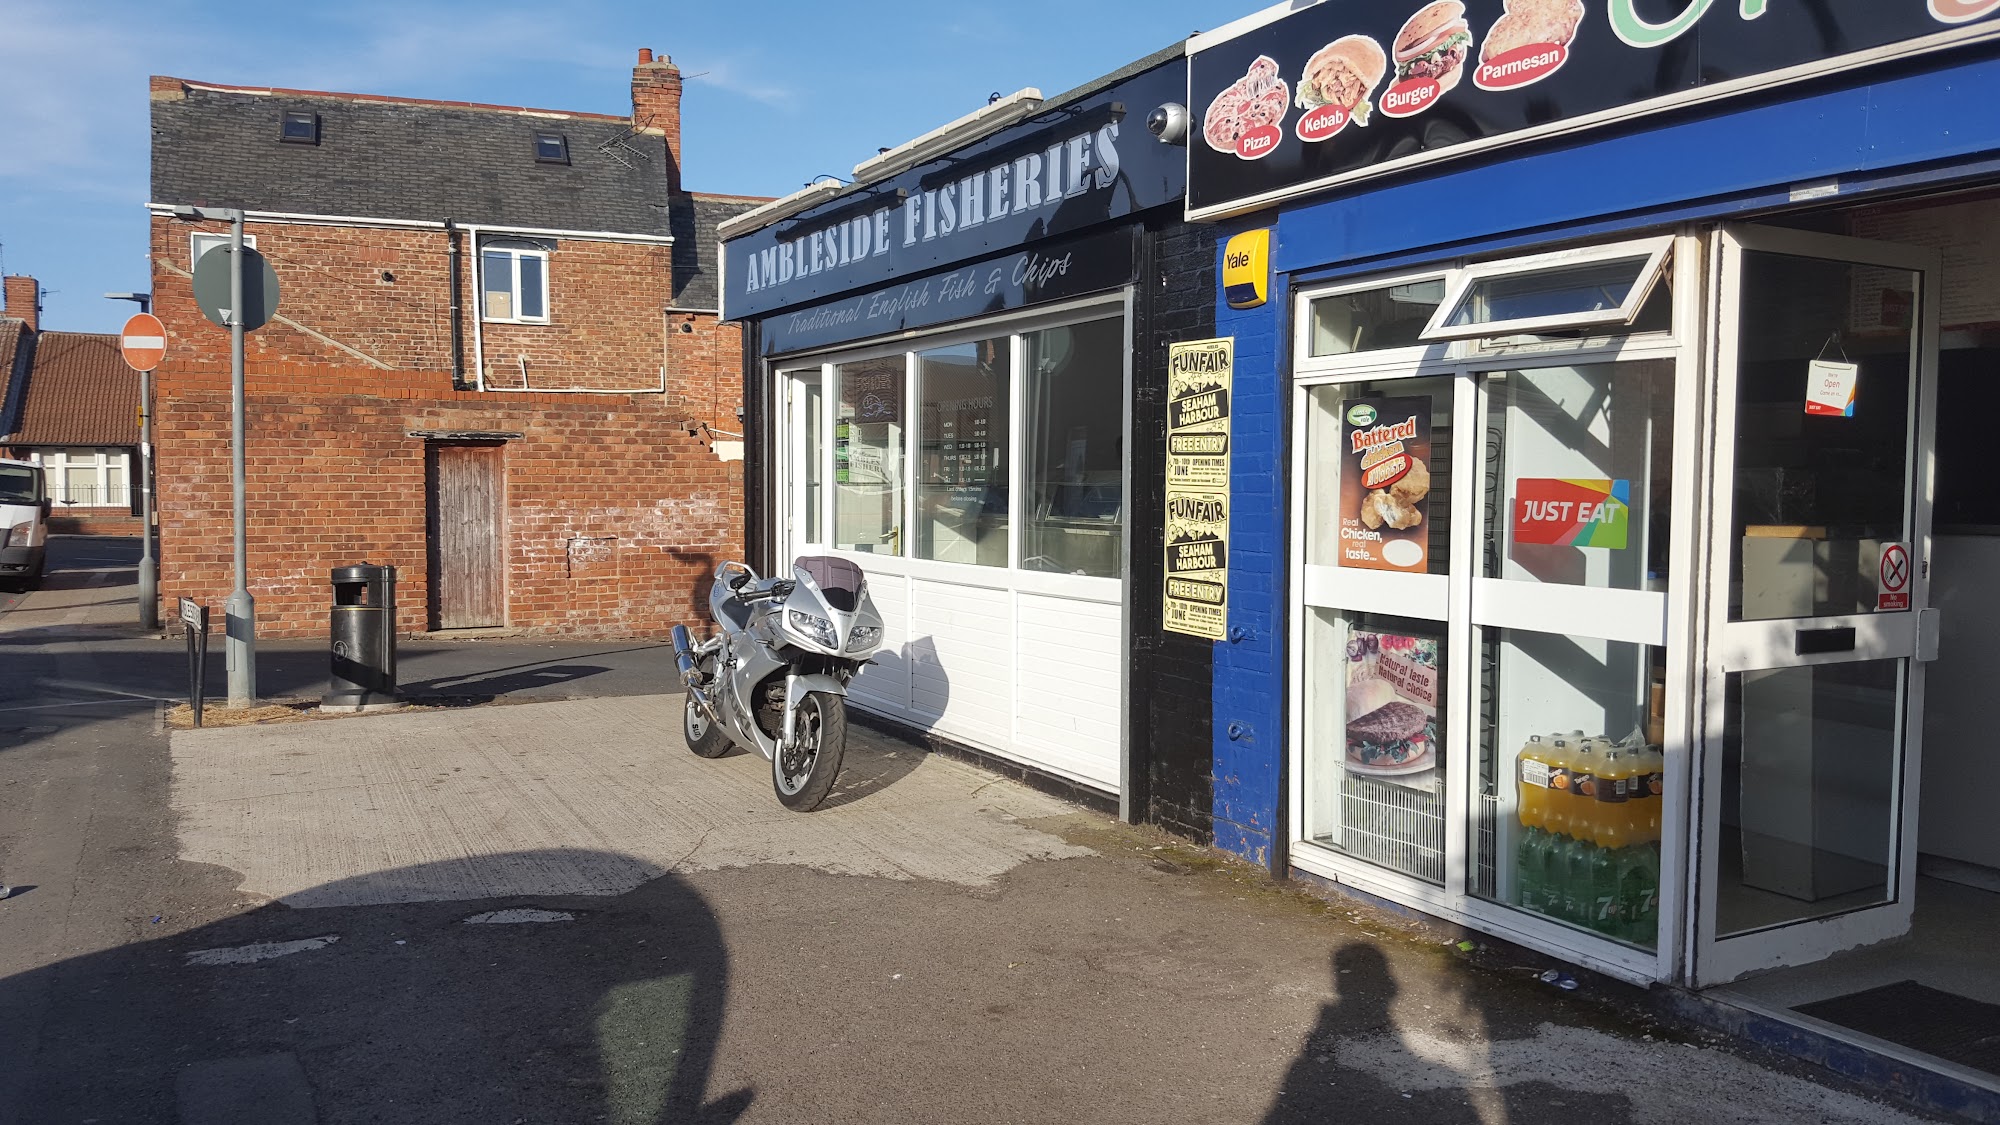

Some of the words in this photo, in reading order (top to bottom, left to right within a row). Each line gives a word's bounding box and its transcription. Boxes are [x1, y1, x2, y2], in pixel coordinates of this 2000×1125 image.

[1482, 48, 1560, 81] Parmesan
[1386, 84, 1436, 110] Burger
[1304, 108, 1344, 133] Kebab
[1243, 134, 1271, 153] Pizza
[746, 206, 892, 294] AMBLESIDE
[903, 121, 1121, 249] FISHERIES
[1227, 251, 1249, 269] Yale
[788, 297, 864, 335] Traditional
[867, 281, 930, 321] English
[938, 269, 976, 303] Fish
[984, 267, 1002, 294] &
[1011, 253, 1072, 288] Chips
[1171, 348, 1230, 378] FUNFAIR
[1824, 378, 1841, 389] Open
[968, 396, 993, 410] HOURS
[1181, 393, 1216, 412] SEAHAM
[1179, 406, 1219, 426] HARBOUR
[1171, 436, 1193, 453] FREE
[1194, 434, 1227, 453] ENTRY
[1352, 417, 1415, 452] Battered
[1174, 465, 1188, 476] JUNE
[1192, 458, 1211, 467] OPENING
[1212, 458, 1225, 467] TIMES
[1366, 456, 1407, 487] NUGGETS
[1168, 498, 1226, 522] FUNFAIR
[1521, 500, 1573, 524] JUST
[1577, 502, 1620, 524] EAT
[1342, 517, 1359, 527] Real
[1340, 527, 1383, 543] Chicken,
[1352, 540, 1366, 548] real
[1178, 543, 1213, 558] SEAHAM
[1176, 555, 1216, 570] HARBOUR
[1168, 579, 1191, 597] FREE
[1192, 582, 1223, 602] ENTRY
[1190, 604, 1207, 614] OPENING
[1209, 607, 1221, 616] TIMES
[1883, 600, 1904, 608] smoking
[1172, 609, 1186, 620] JUNE
[1409, 668, 1430, 687] taste
[1406, 682, 1433, 702] choice
